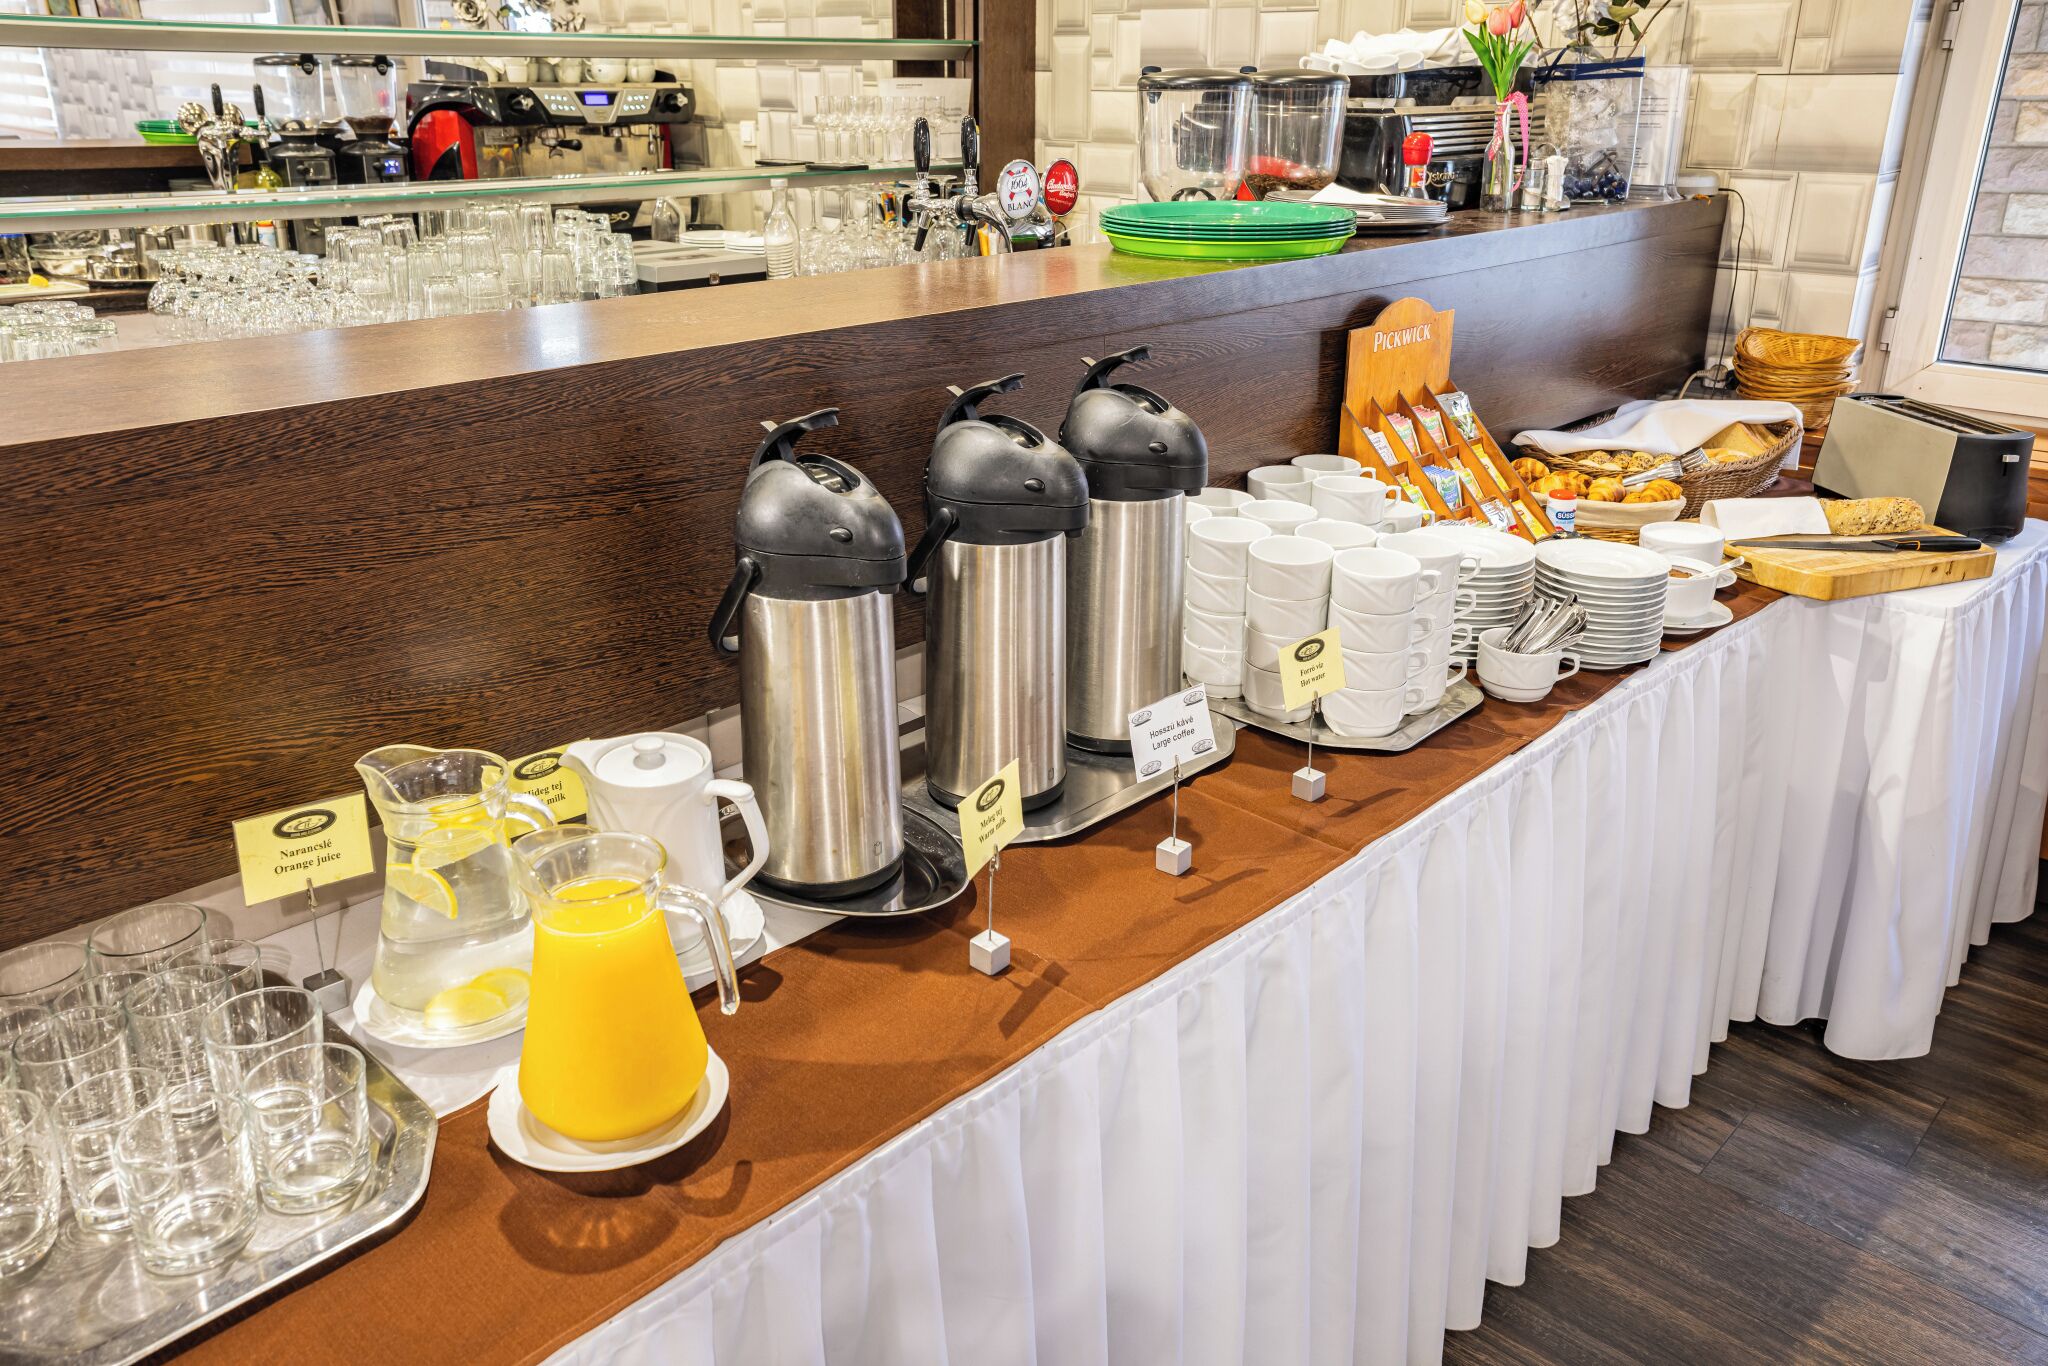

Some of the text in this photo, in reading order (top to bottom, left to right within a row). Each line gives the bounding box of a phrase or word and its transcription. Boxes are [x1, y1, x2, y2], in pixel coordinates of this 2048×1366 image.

[1010, 177, 1028, 190] 1664
[1007, 199, 1033, 212] BLANC
[1300, 672, 1326, 688] Hot water
[1149, 715, 1194, 740] Hosszú kávé
[1152, 728, 1195, 751] Large coffee
[552, 781, 563, 790] tej
[547, 793, 566, 805] milk
[979, 828, 995, 844] Warm
[280, 838, 332, 859] Narancslé
[274, 852, 341, 875] Orange juice
